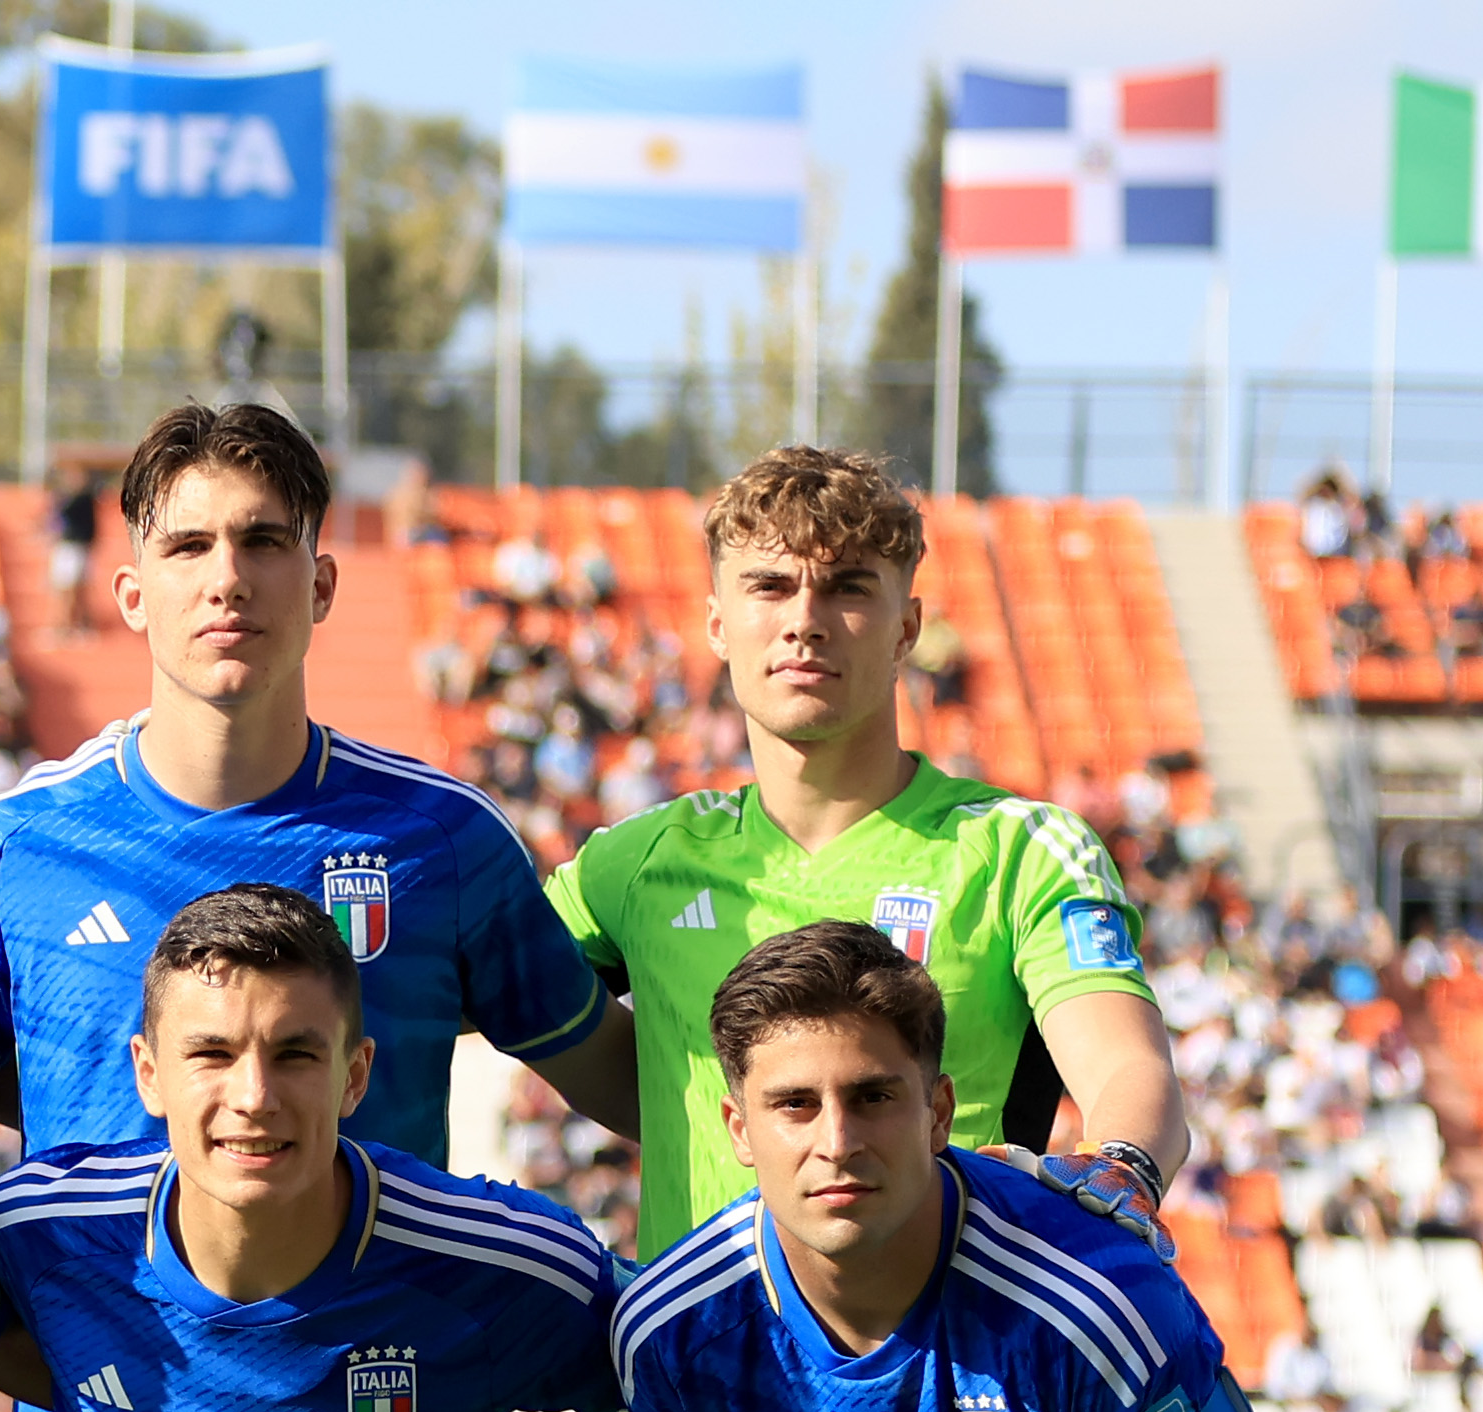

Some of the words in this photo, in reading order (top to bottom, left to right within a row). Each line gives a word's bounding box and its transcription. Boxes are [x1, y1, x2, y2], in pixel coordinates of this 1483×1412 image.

[78, 112, 296, 199] FIFA
[330, 877, 384, 896] ITALIA
[883, 900, 929, 921] ITALIA
[353, 1371, 411, 1391] ITALIA
